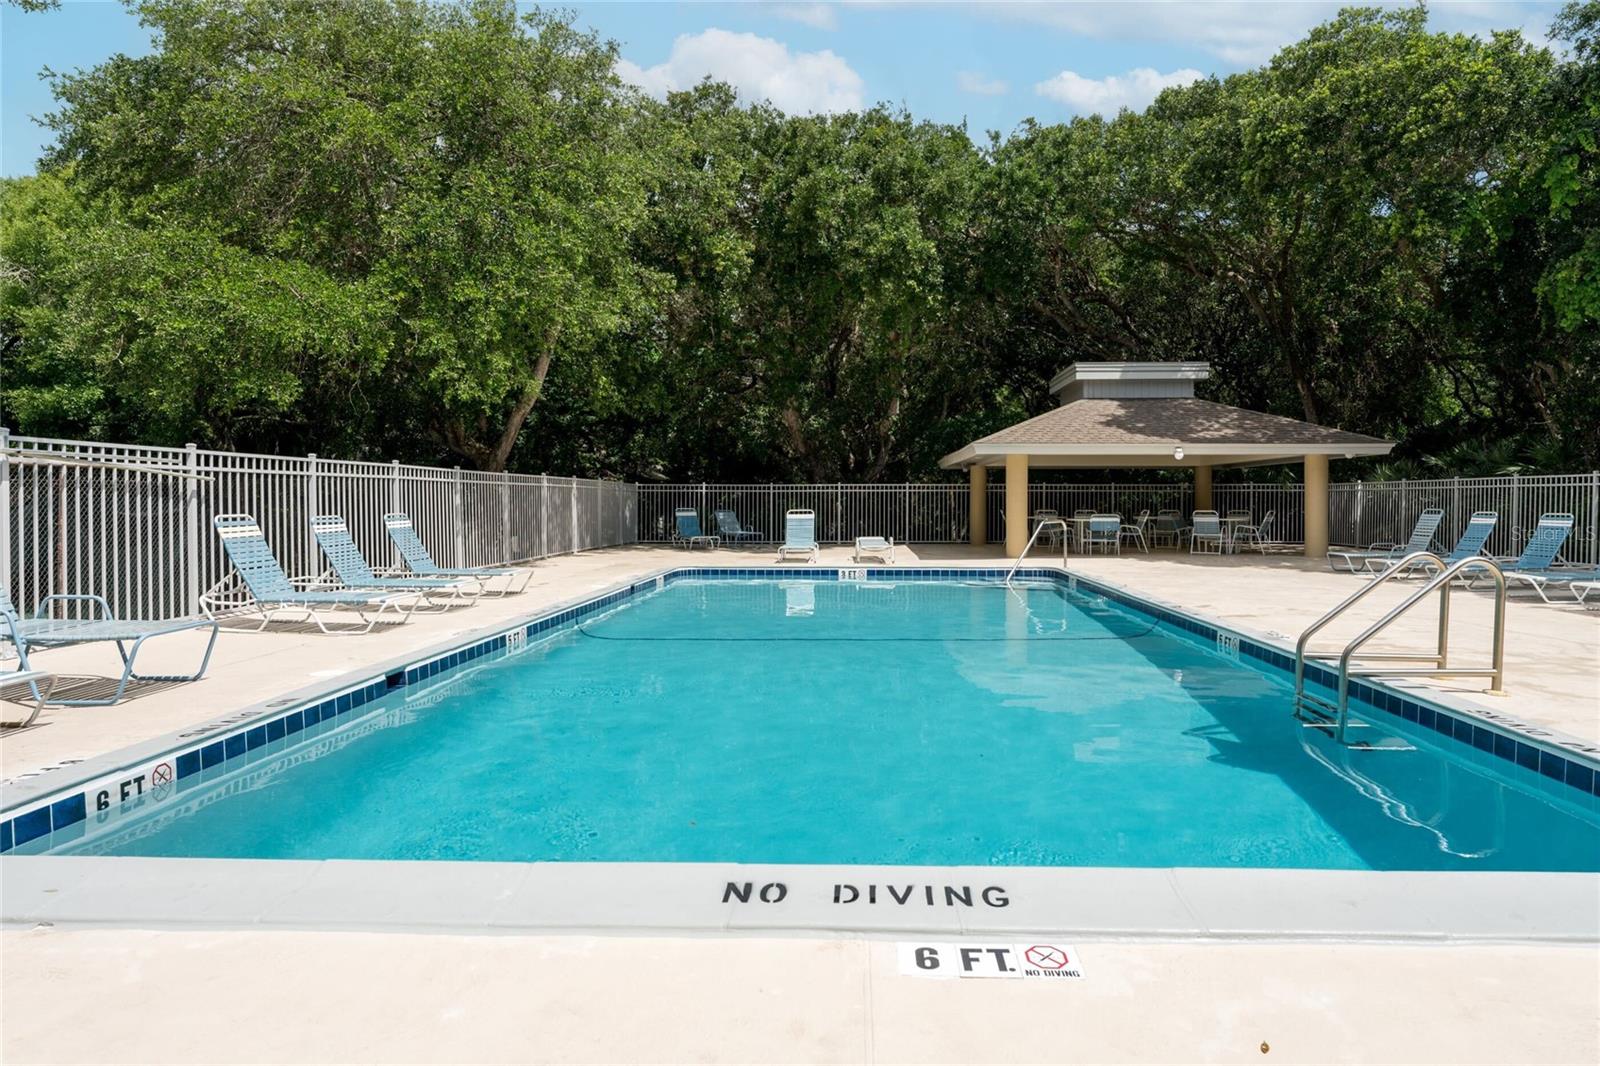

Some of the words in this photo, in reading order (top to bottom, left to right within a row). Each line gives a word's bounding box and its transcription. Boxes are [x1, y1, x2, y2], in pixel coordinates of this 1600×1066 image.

[96, 790, 110, 812] 6
[721, 882, 788, 904] NO
[833, 883, 1010, 908] DIVING
[914, 947, 940, 970] 6
[959, 948, 1016, 972] FT.
[1025, 969, 1041, 977] NO
[1043, 970, 1081, 978] DIVING
